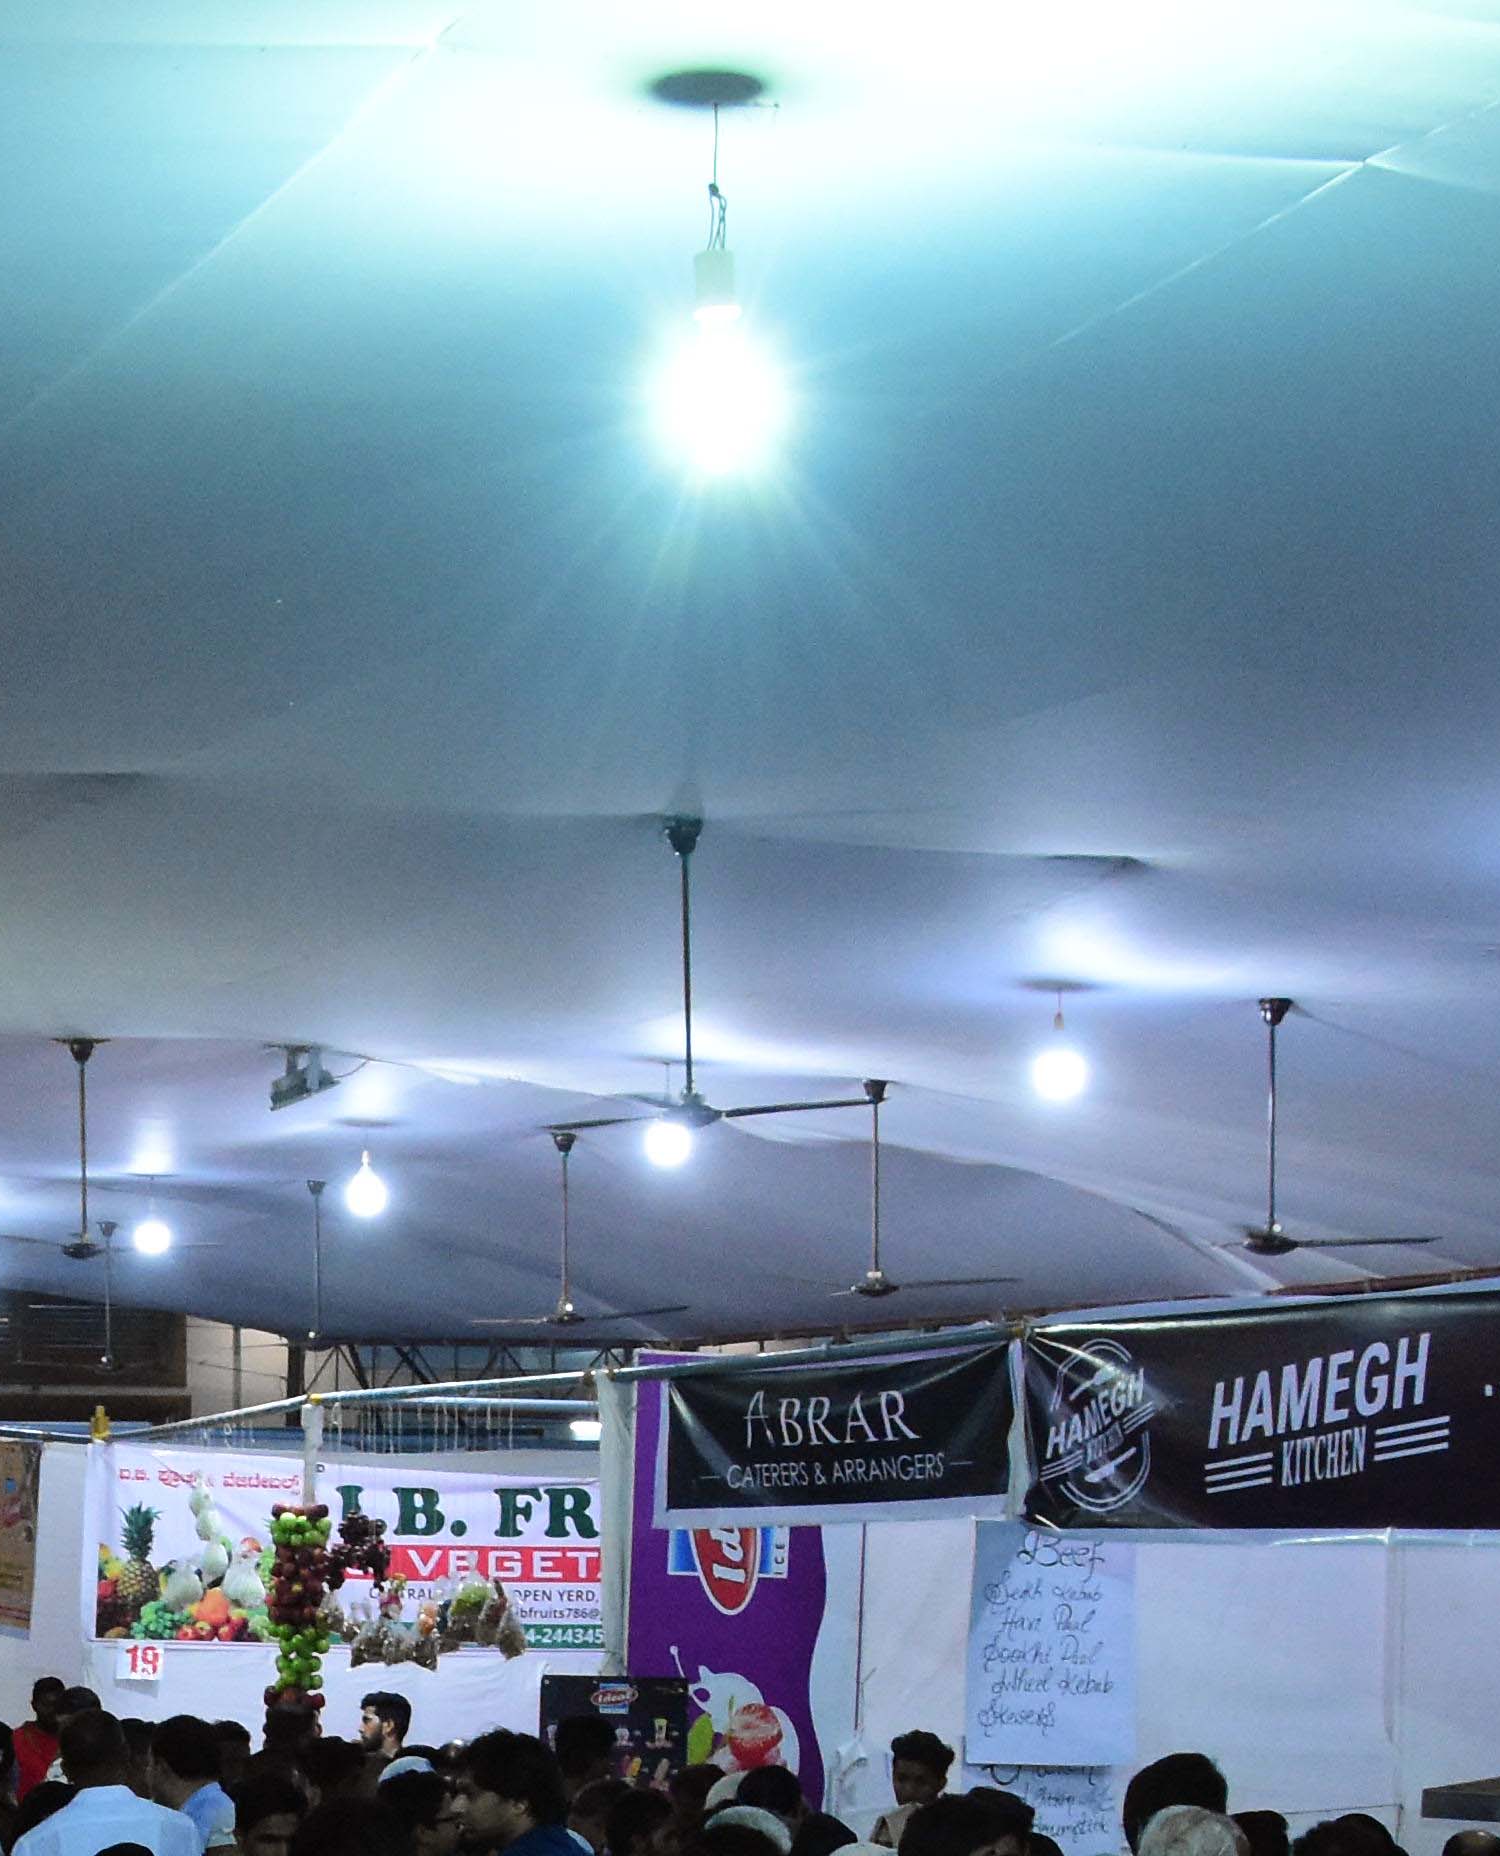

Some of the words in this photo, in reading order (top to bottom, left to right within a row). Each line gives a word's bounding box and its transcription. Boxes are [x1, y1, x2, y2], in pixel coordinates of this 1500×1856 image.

[1207, 1333, 1432, 1449] HAMEGH
[743, 1390, 922, 1449] ABRAR
[726, 1460, 809, 1489] CATERERS
[813, 1462, 827, 1485] &
[832, 1451, 945, 1483] ARRANGERS
[1281, 1426, 1367, 1487] KITCHEN
[407, 1549, 601, 1579] VEGET
[1016, 1529, 1106, 1584] Beef
[125, 1644, 160, 1675] 19
